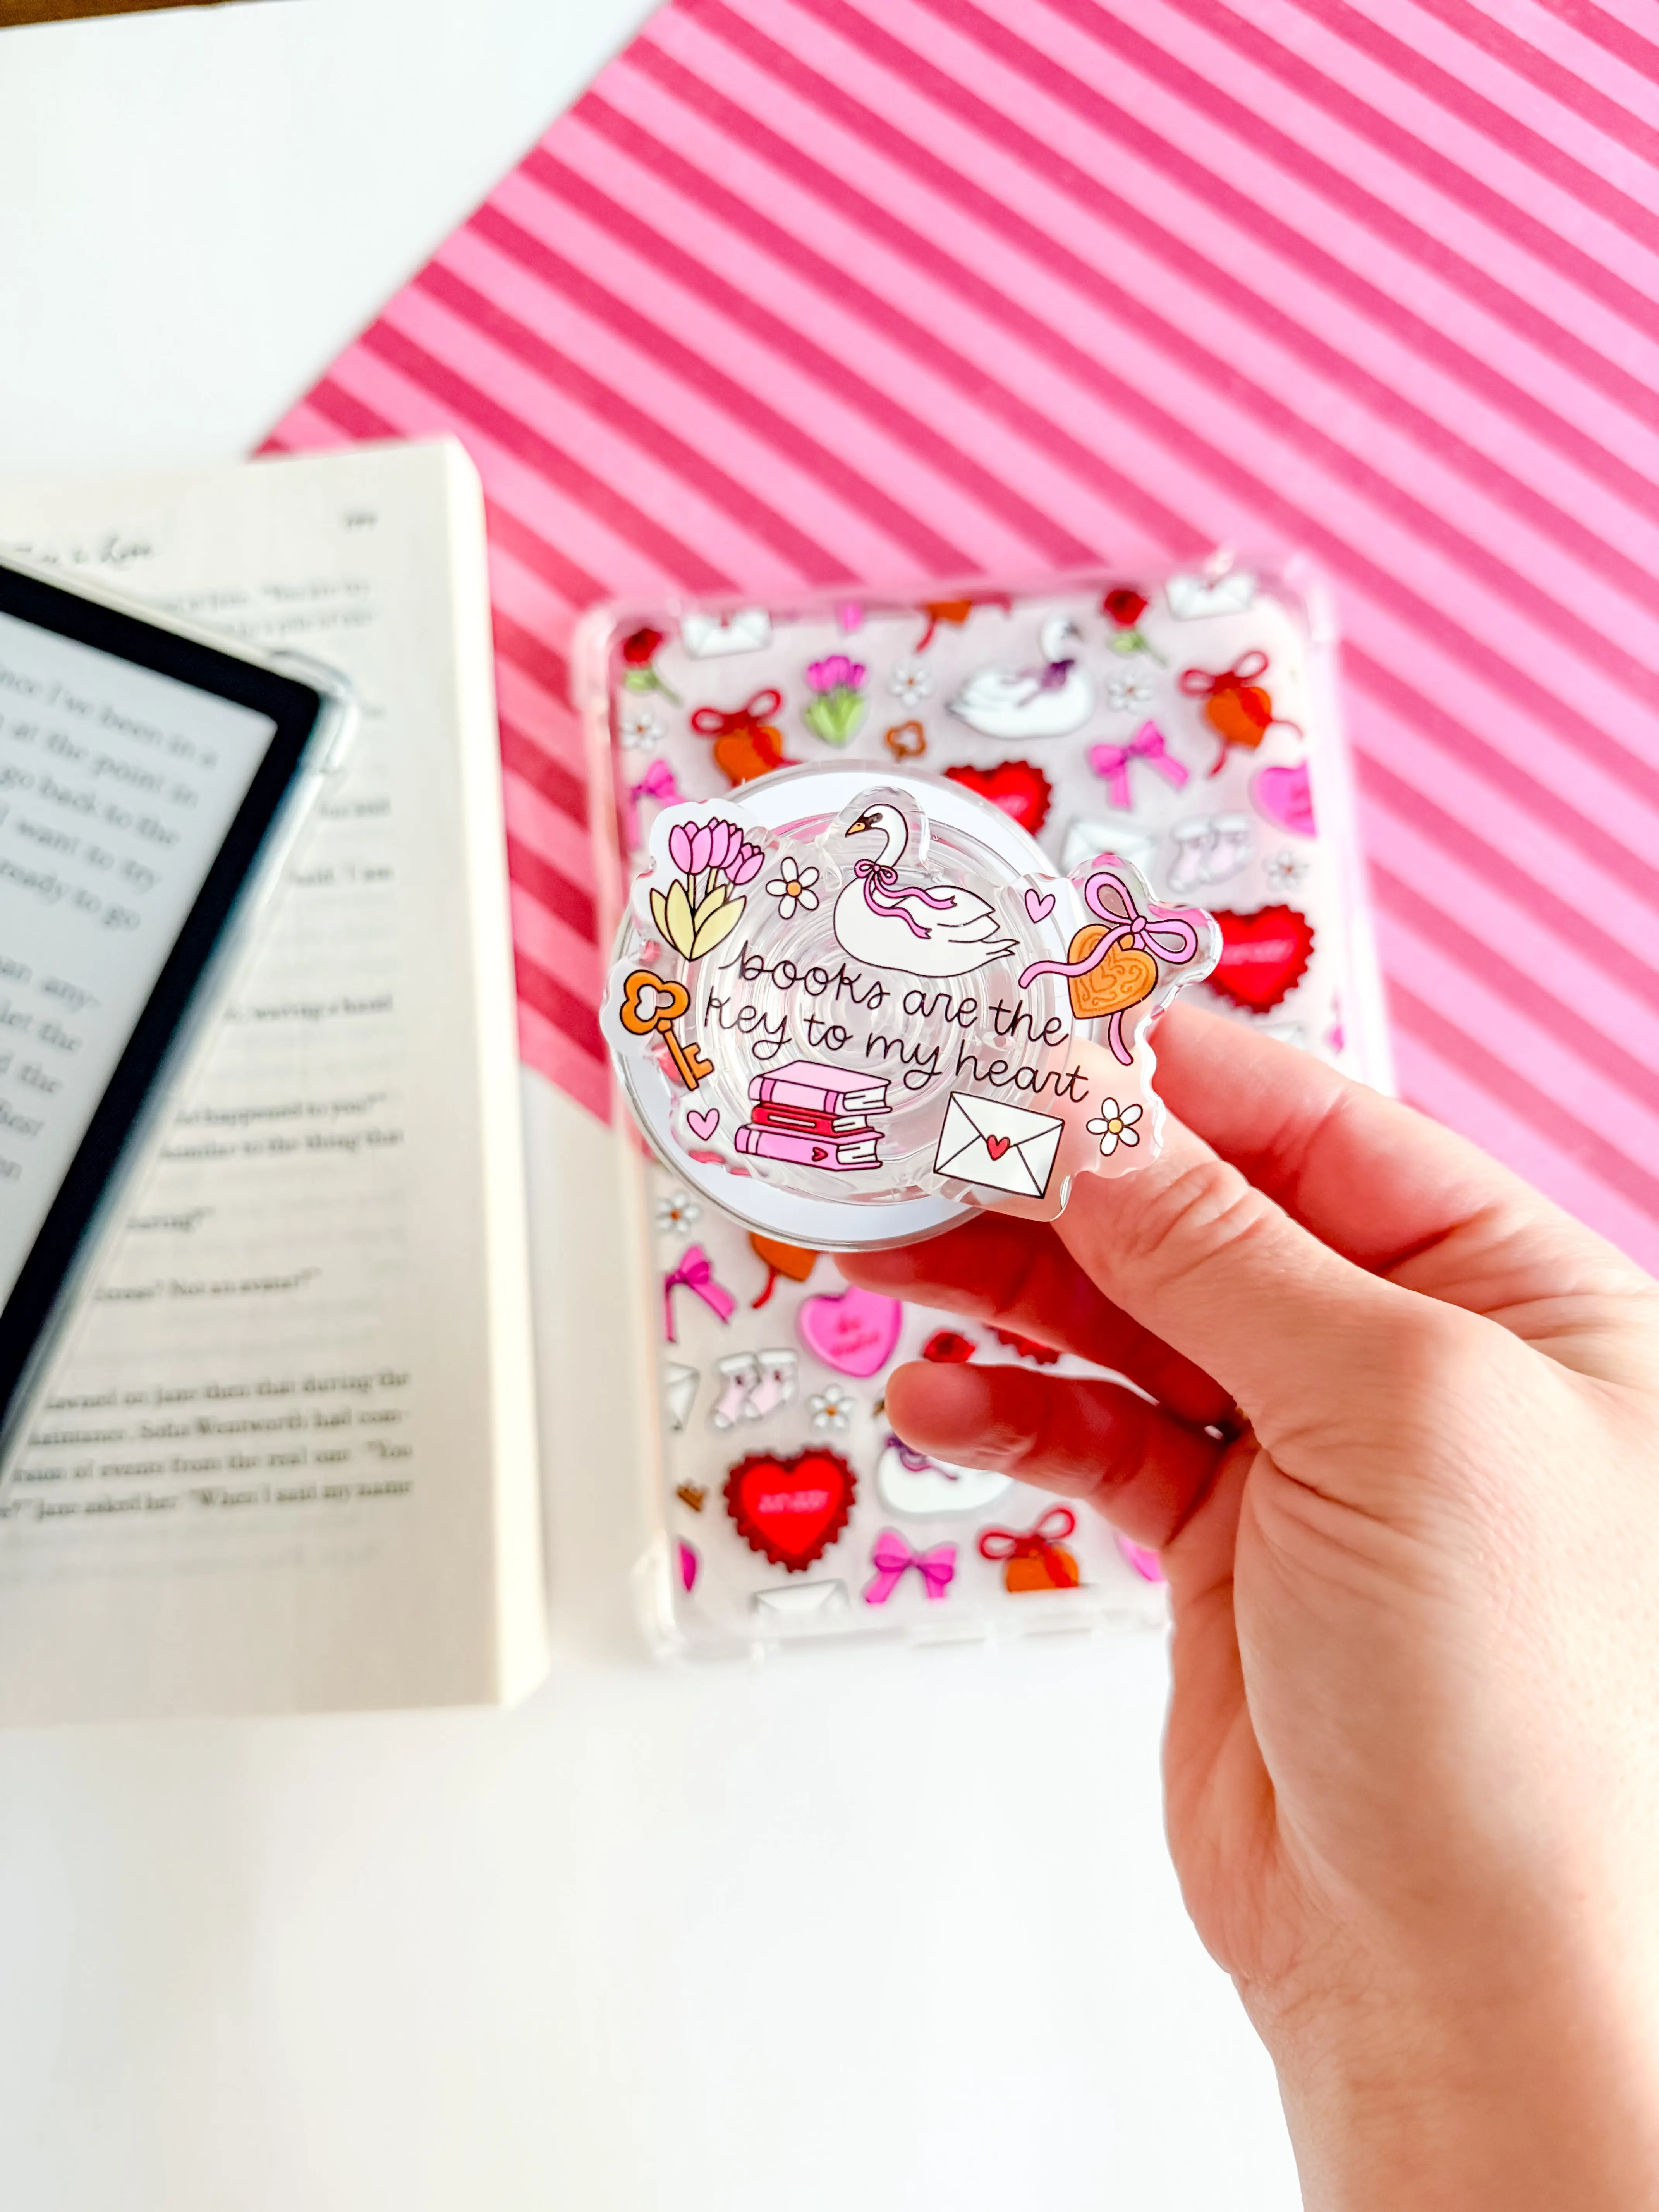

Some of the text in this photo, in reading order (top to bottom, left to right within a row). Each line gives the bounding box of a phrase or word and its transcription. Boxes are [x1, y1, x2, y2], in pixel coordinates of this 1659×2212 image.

[46, 732, 89, 760] the
[91, 750, 167, 793] point
[169, 781, 199, 808] in
[99, 704, 164, 747] been
[167, 733, 196, 757] in
[200, 750, 218, 769] a
[40, 774, 98, 817] back
[103, 804, 132, 829] to
[136, 816, 180, 845] the
[15, 819, 80, 855] want
[84, 846, 115, 871] to
[121, 859, 163, 893] try
[73, 888, 101, 914] to
[102, 904, 141, 931] go
[719, 941, 1068, 1046] books are the
[40, 1018, 82, 1052] the
[804, 1014, 854, 1050] to
[866, 1033, 941, 1090] my
[956, 1041, 1089, 1103] heart
[17, 1061, 63, 1094] the
